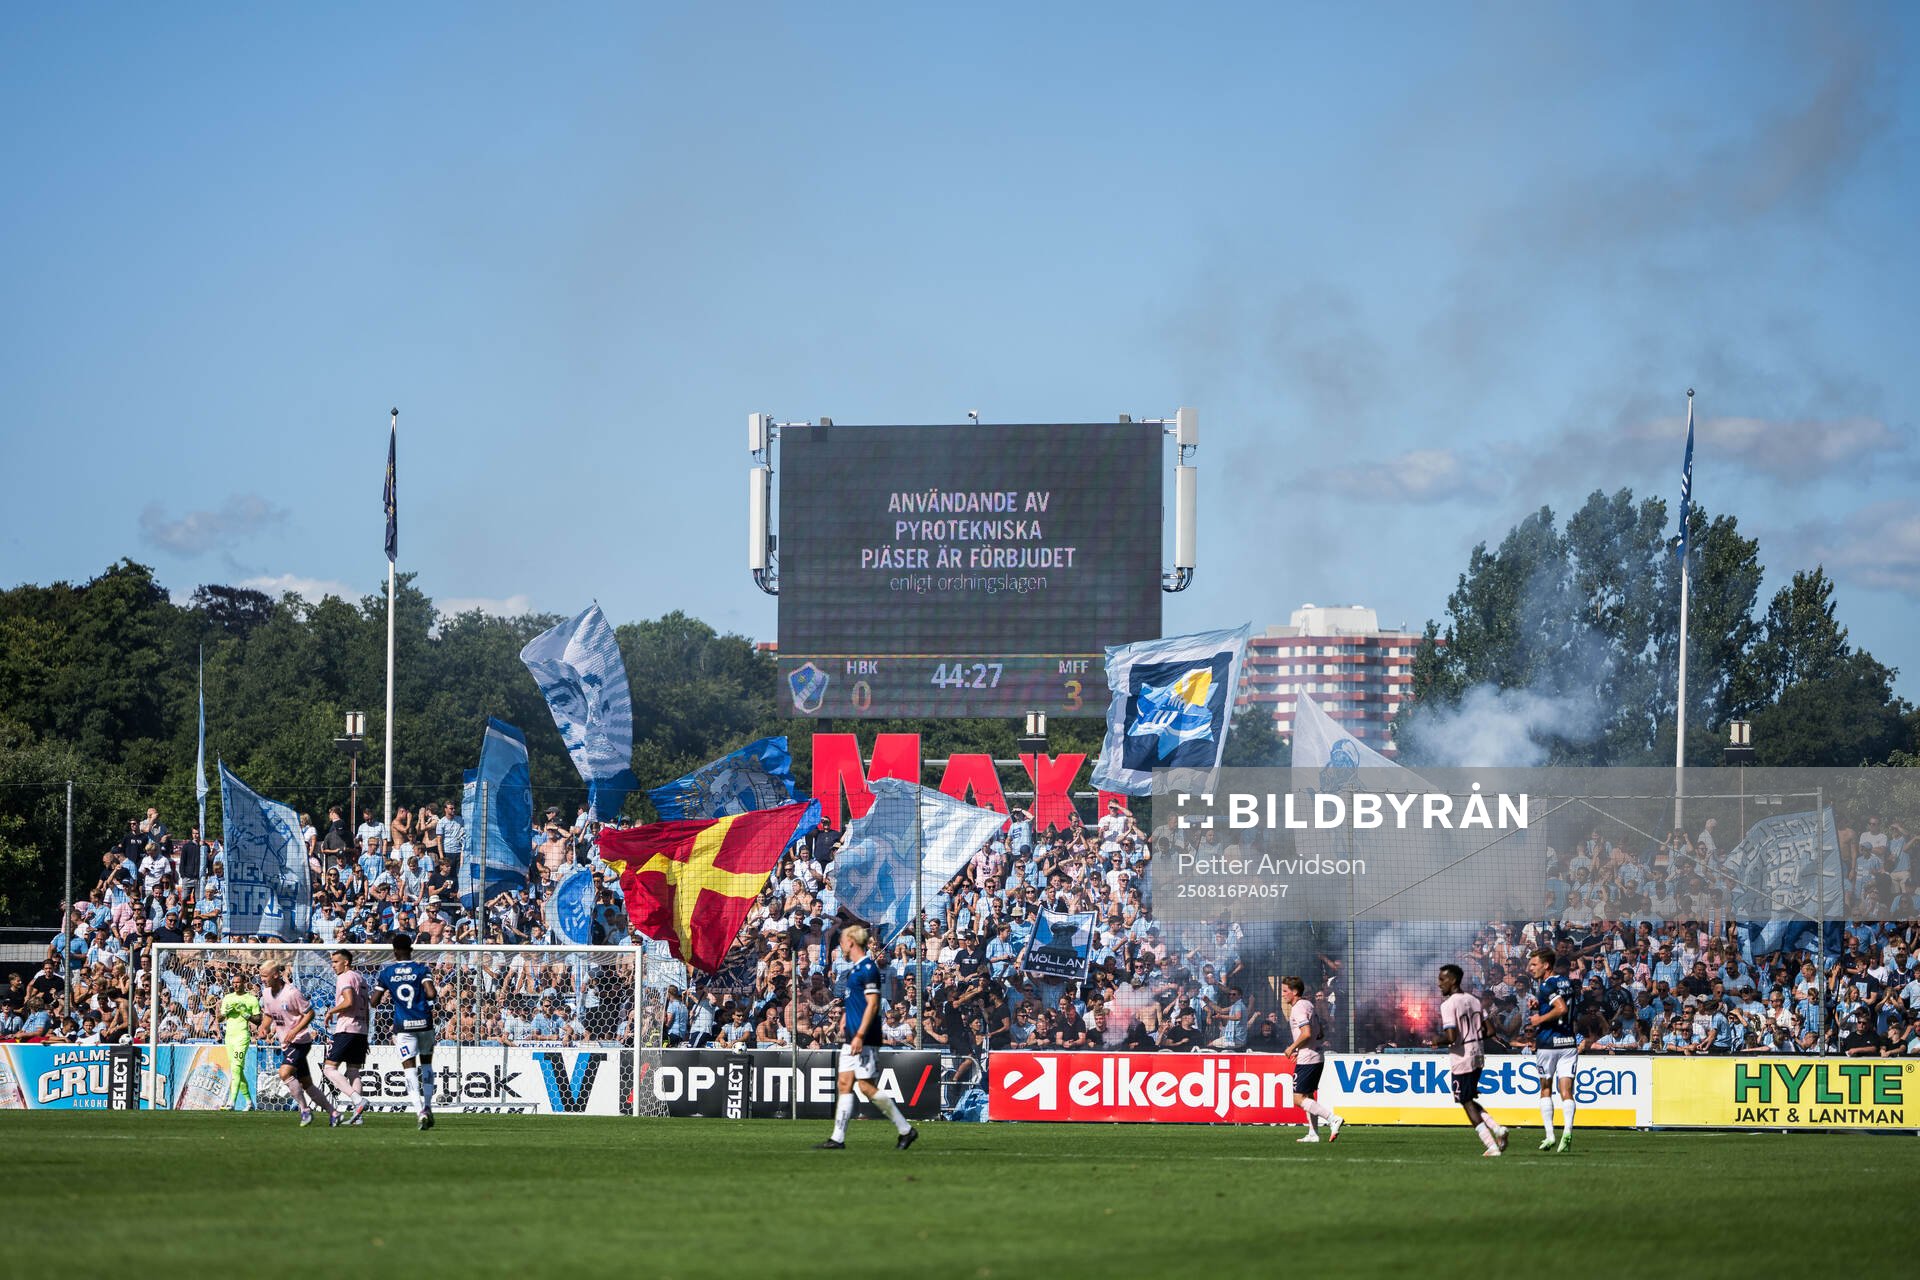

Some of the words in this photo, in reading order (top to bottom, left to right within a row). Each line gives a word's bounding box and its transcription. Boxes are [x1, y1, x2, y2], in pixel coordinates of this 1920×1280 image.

[888, 488, 1018, 513] ANVÄNDANDE
[1025, 491, 1050, 513] AV
[895, 519, 1042, 541] PYROTEKNISKA
[861, 544, 929, 569] PJÄSER
[936, 544, 962, 569] ÄR
[970, 544, 1076, 569] FÖRBJUDET
[889, 573, 933, 595] enligt
[937, 573, 1047, 595] ordningslagen
[846, 660, 878, 675] HBK
[931, 663, 1003, 689] 44:27
[1058, 660, 1089, 675] MFF
[851, 680, 872, 711] 0
[1062, 680, 1083, 711] 3
[1028, 952, 1086, 969] MÖLLAN
[396, 983, 415, 1009] 9
[233, 1051, 245, 1060] 30
[112, 1056, 129, 1110] SELECT
[727, 1062, 744, 1119] SELECT
[1068, 1057, 1294, 1118] elkedjan
[1735, 1063, 1904, 1105] HYLTE
[1735, 1107, 1780, 1123] JAKT
[1787, 1108, 1800, 1123] &
[1809, 1108, 1904, 1125] LANTMAN
